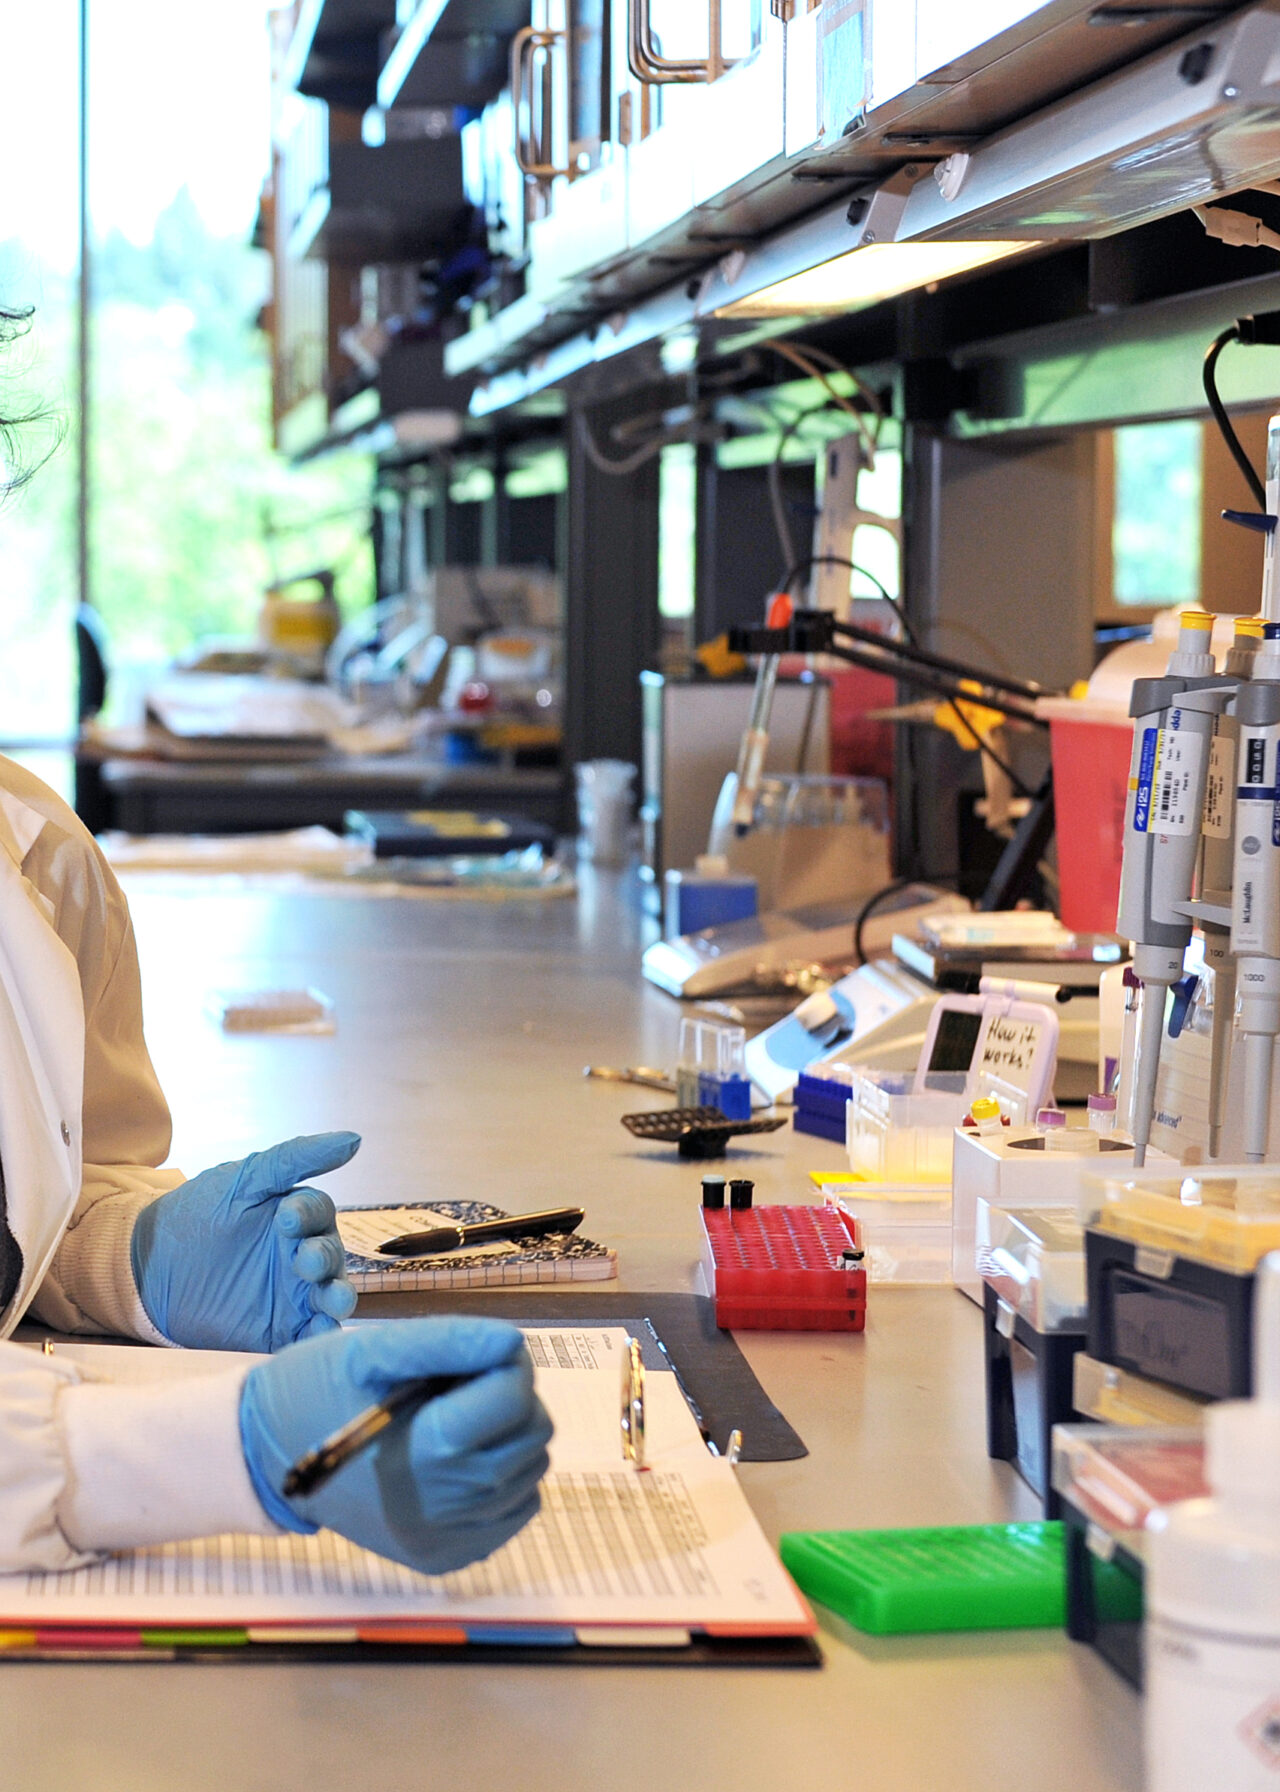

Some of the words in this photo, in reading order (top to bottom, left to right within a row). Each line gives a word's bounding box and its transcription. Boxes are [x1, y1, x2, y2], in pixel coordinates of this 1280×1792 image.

[1210, 948, 1224, 958] 100
[1167, 961, 1178, 969] 20
[1243, 973, 1265, 982] 1000
[987, 1016, 1017, 1042] How
